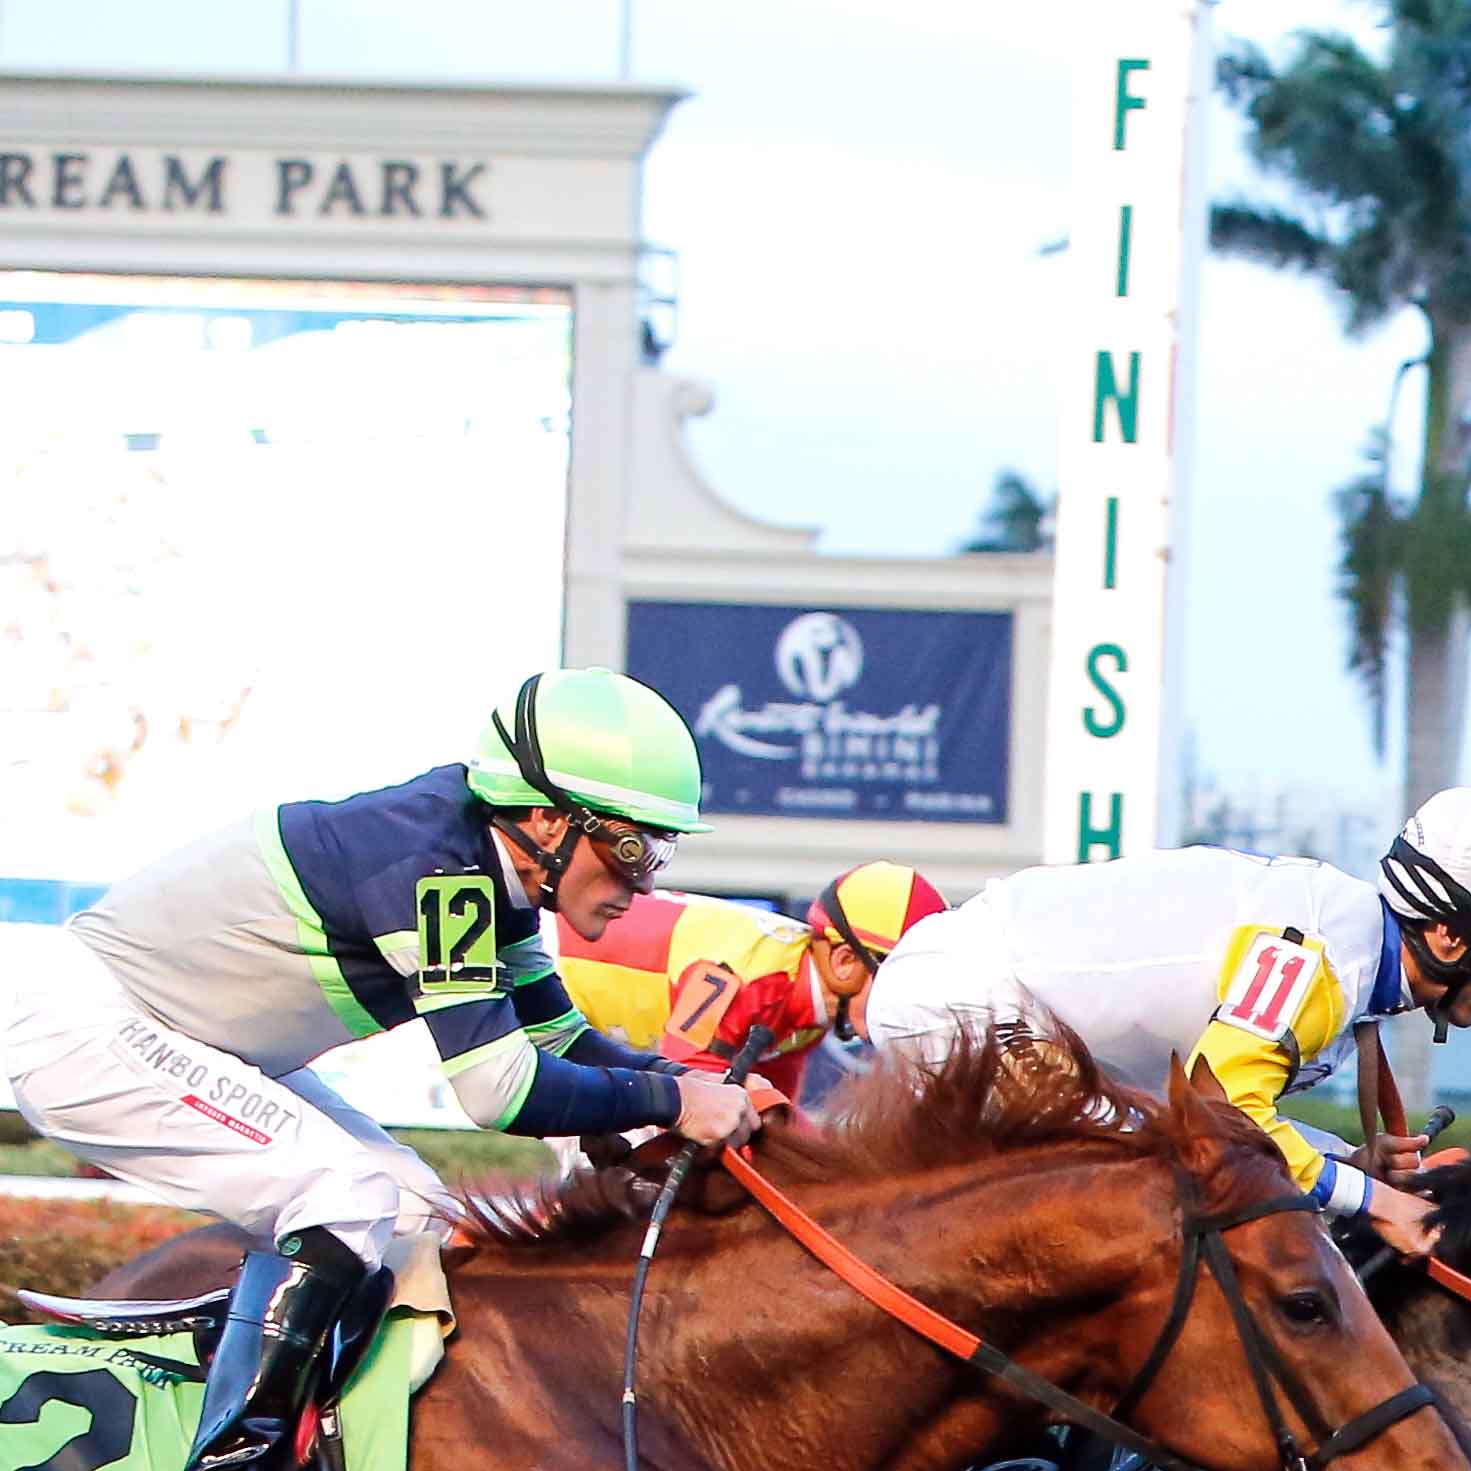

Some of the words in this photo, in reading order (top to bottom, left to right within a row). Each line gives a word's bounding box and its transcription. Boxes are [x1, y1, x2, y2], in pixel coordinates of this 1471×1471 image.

[0, 152, 229, 214] REAM
[274, 156, 487, 220] PARK
[1078, 57, 1150, 862] FINISH
[420, 887, 495, 984] 12
[680, 974, 727, 1032] 7
[1231, 945, 1306, 1033] 11
[209, 1076, 297, 1134] SPORT
[0, 1340, 105, 1357] REAM
